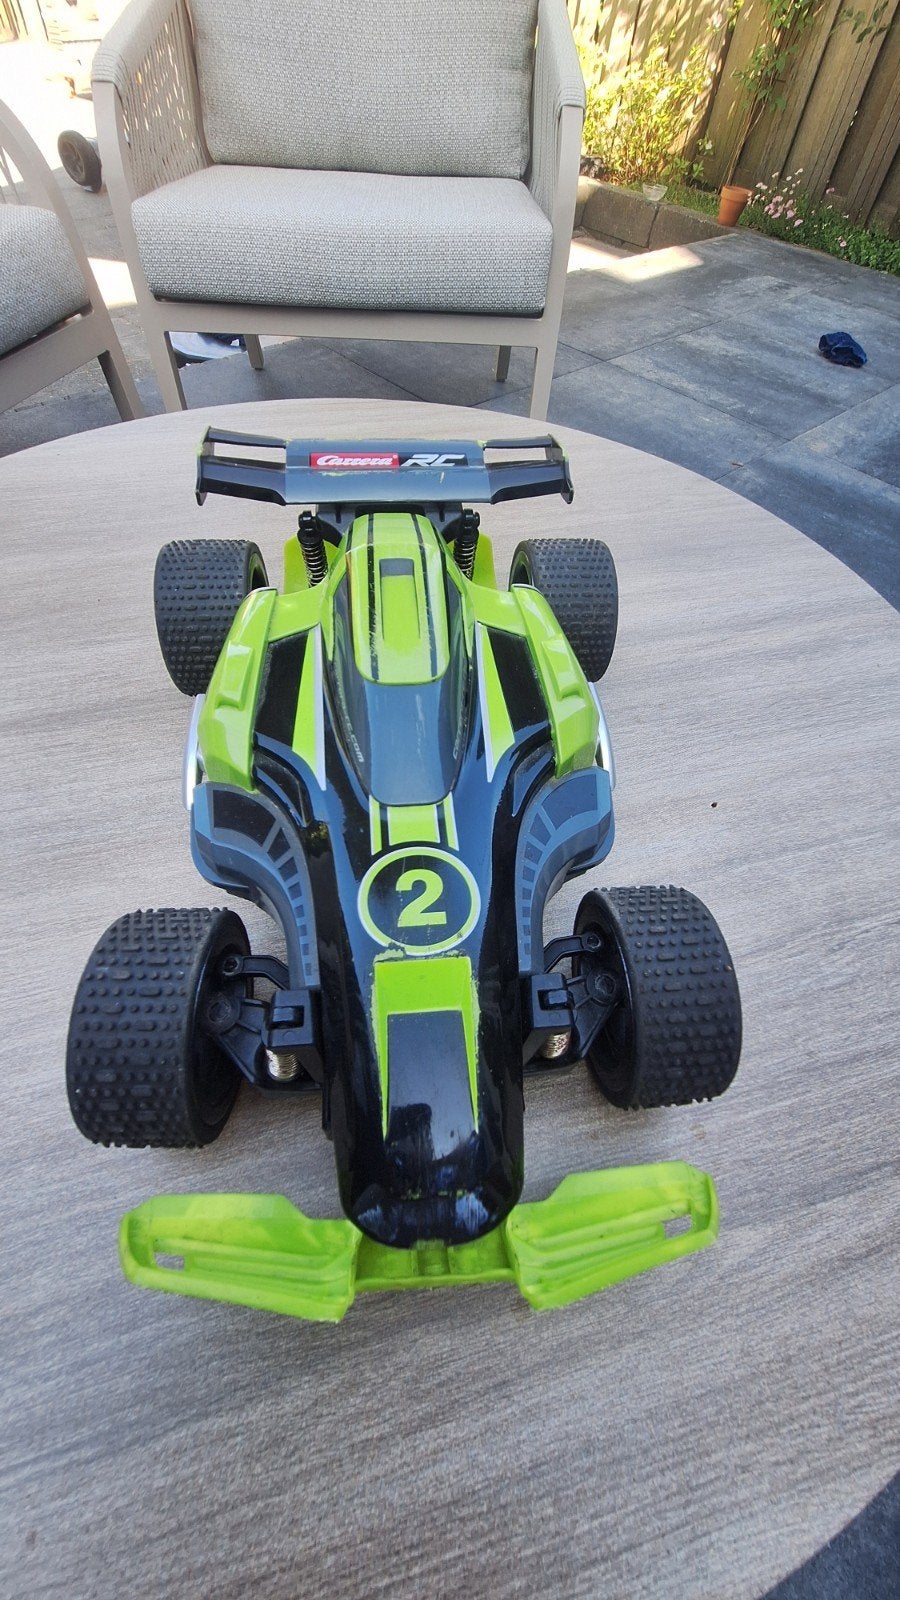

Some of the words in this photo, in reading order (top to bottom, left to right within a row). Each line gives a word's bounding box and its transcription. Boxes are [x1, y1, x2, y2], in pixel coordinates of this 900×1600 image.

[316, 454, 394, 467] Carrera
[401, 453, 466, 467] RC
[395, 868, 447, 928] 2
